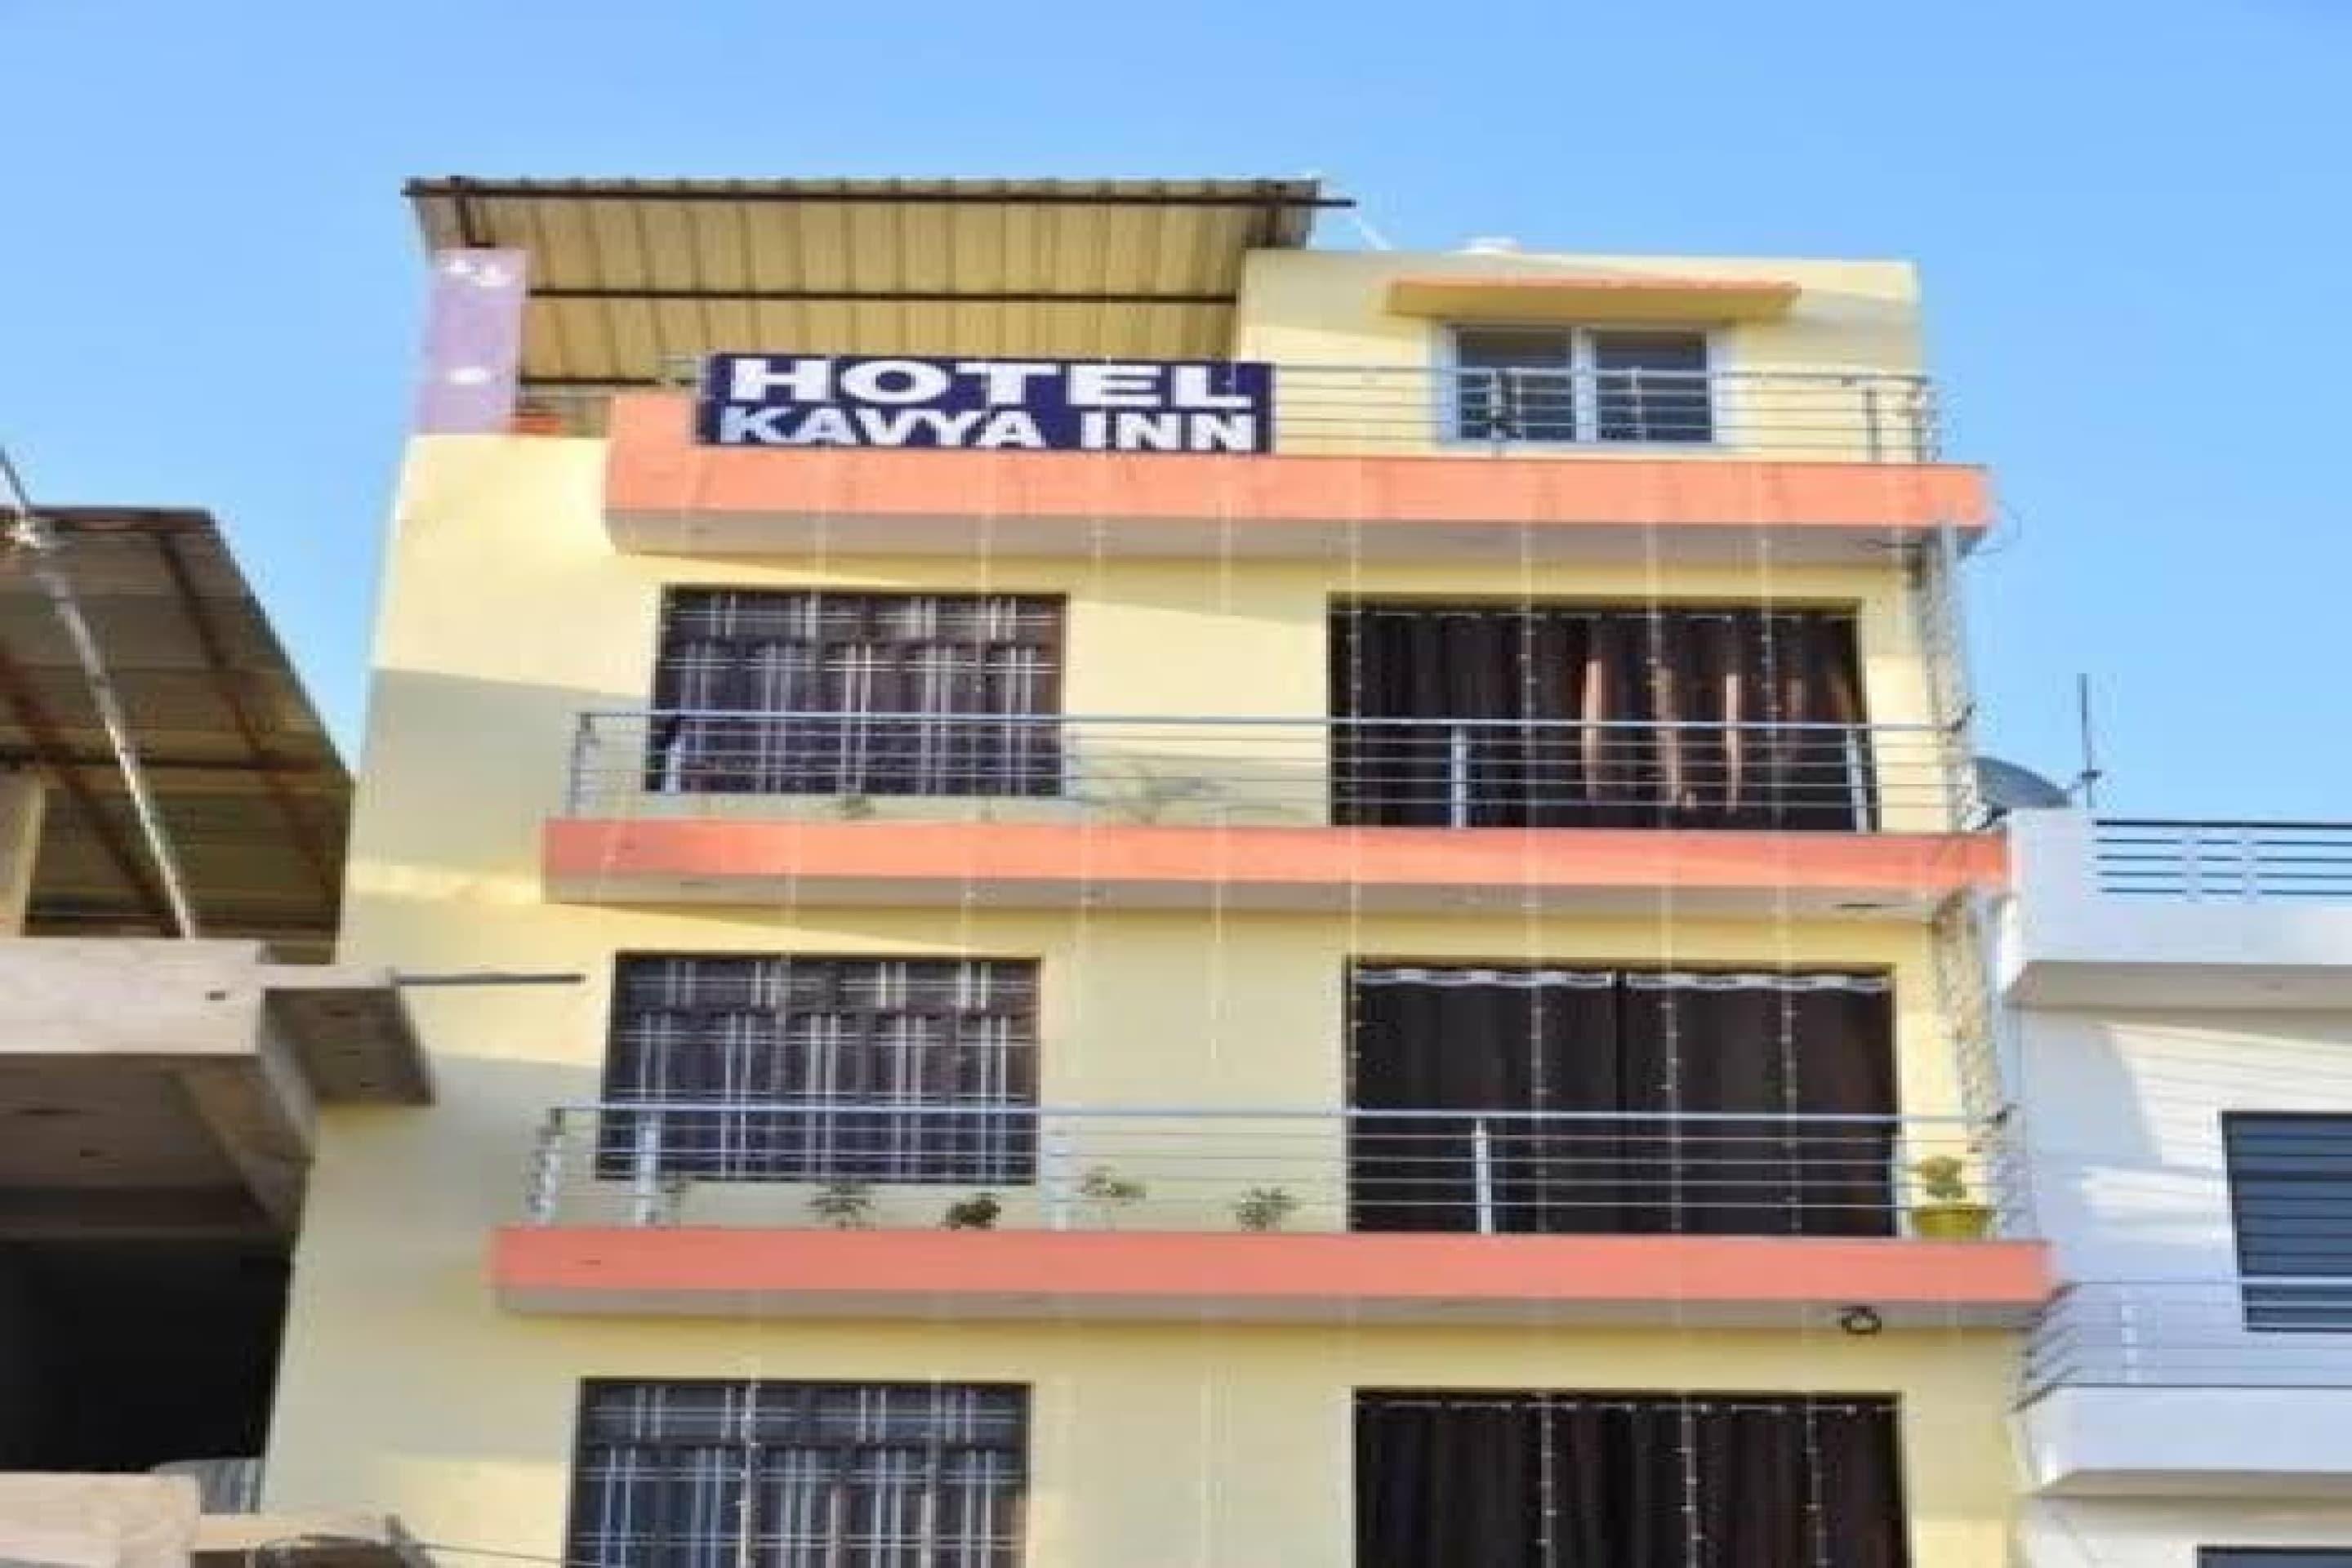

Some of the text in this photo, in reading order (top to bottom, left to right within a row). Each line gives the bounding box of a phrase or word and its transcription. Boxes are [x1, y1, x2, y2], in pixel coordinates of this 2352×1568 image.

[728, 359, 1254, 408] HOTEL
[719, 408, 1254, 452] KAVYA INN
